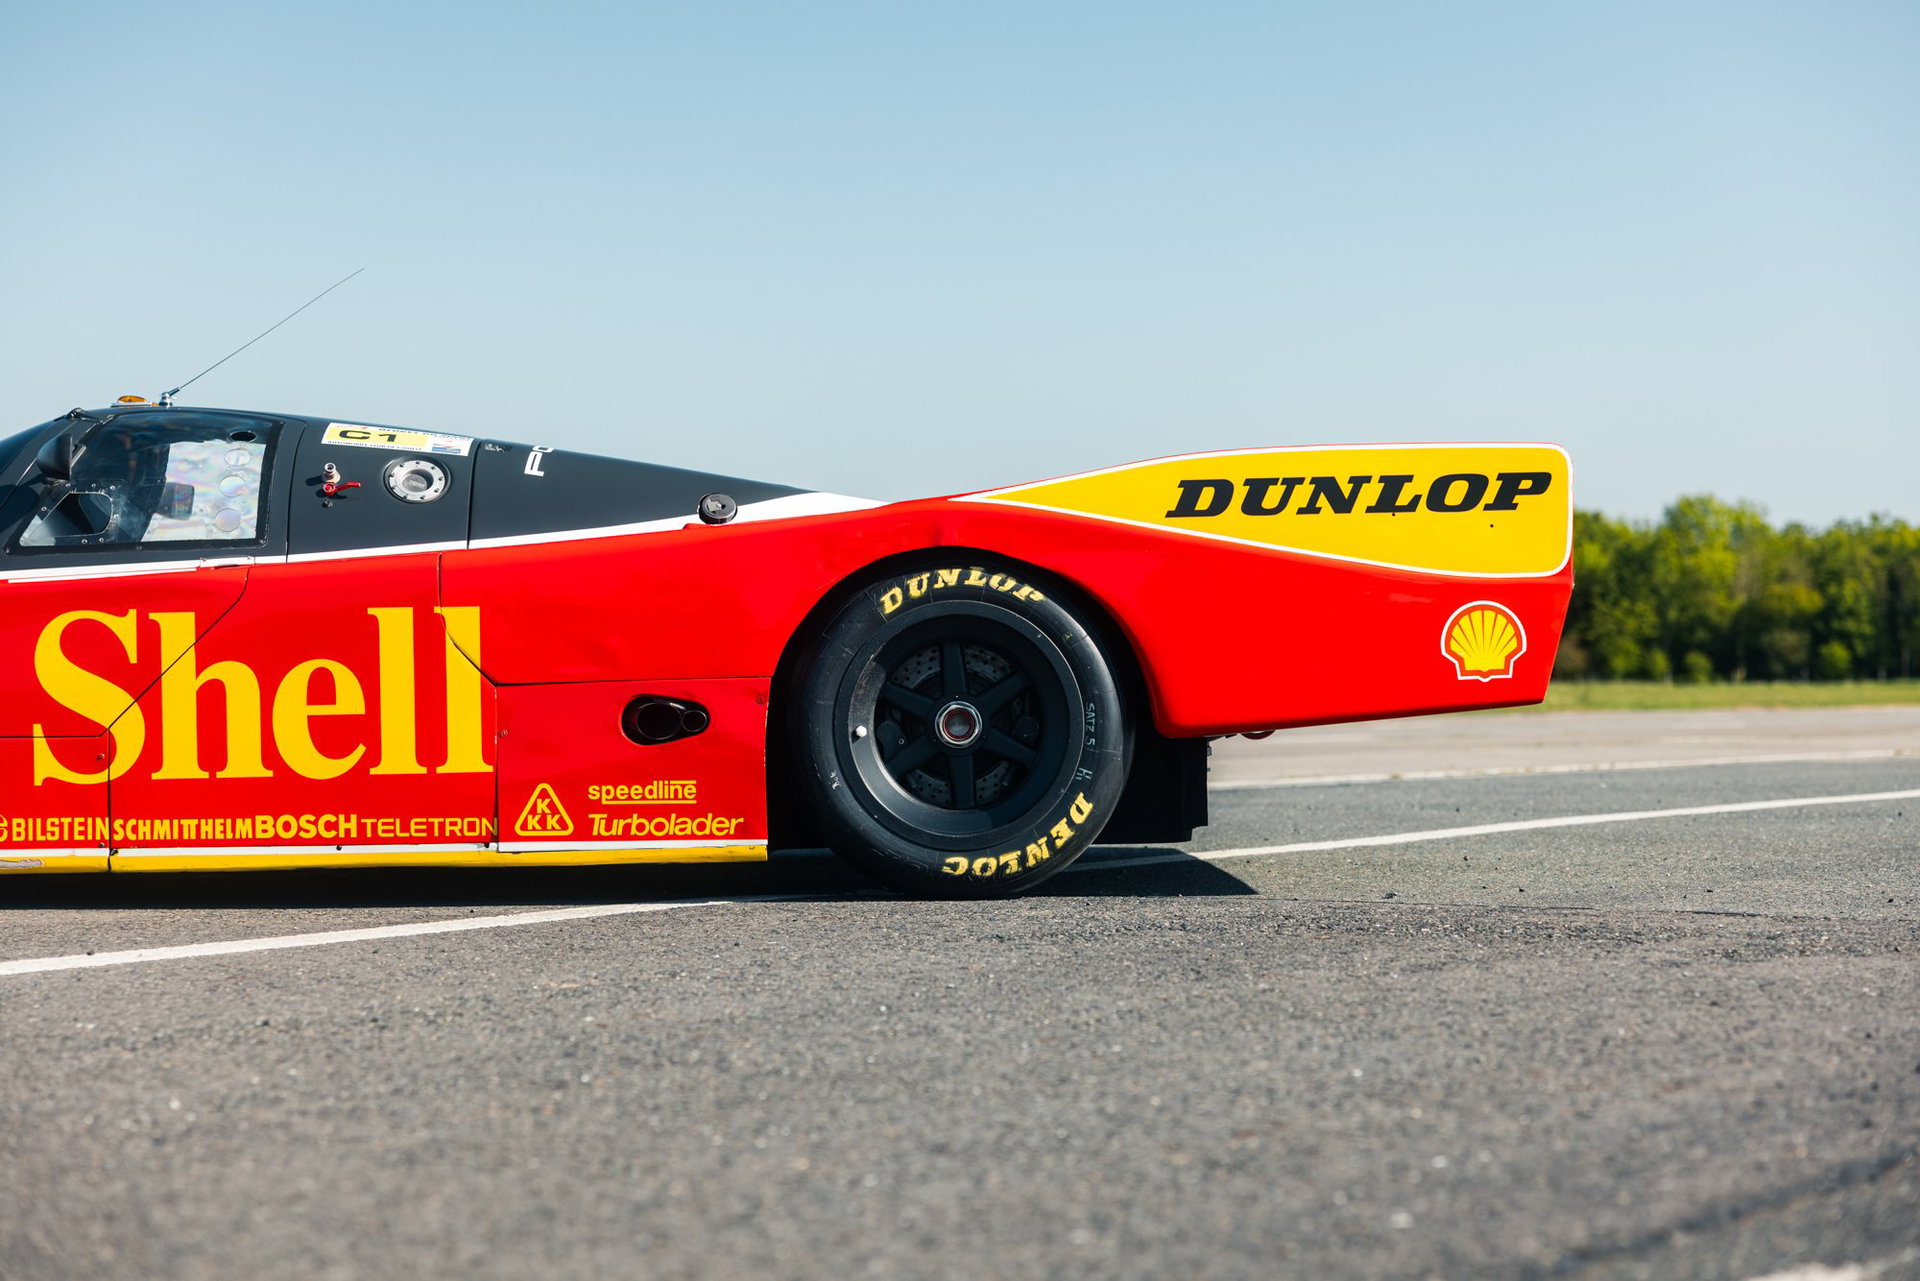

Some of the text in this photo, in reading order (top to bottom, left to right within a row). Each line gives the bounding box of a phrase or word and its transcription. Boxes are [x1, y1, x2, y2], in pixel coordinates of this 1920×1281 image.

[339, 429, 396, 442] C1
[1165, 472, 1552, 518] DUNLOP
[880, 566, 1045, 615] DUNLOP
[33, 606, 494, 786] Shell
[587, 780, 697, 804] speedline
[12, 814, 498, 841] BILSTEIN SCHMITTHELM BOSCH TELETRON
[588, 813, 744, 836] Turbolader
[942, 792, 1094, 877] DENLOC
